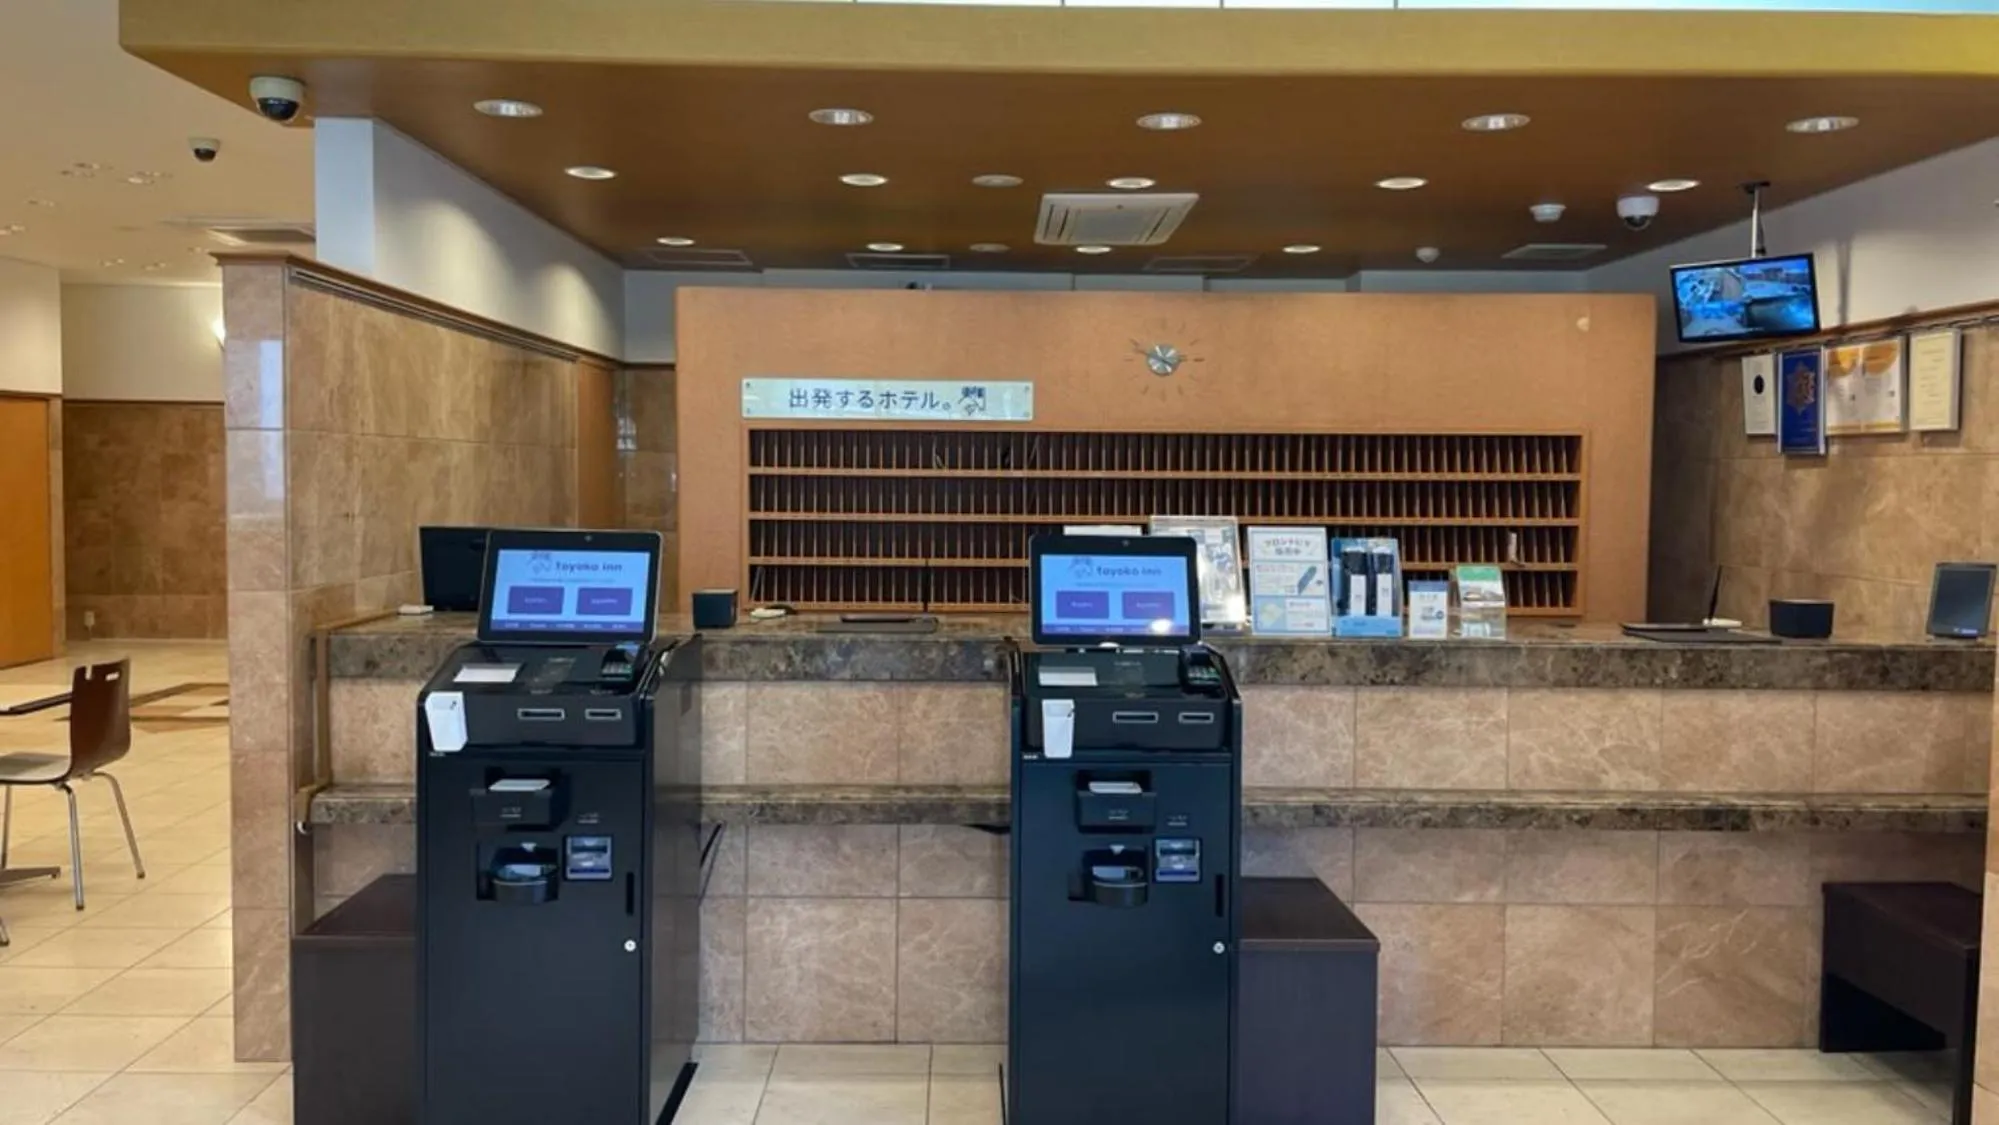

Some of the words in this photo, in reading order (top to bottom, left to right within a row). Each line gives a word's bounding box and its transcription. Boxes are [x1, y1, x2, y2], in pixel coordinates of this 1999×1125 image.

[788, 387, 951, 411] 出発するホテル。
[602, 561, 623, 572] inn
[1141, 565, 1162, 576] inn
